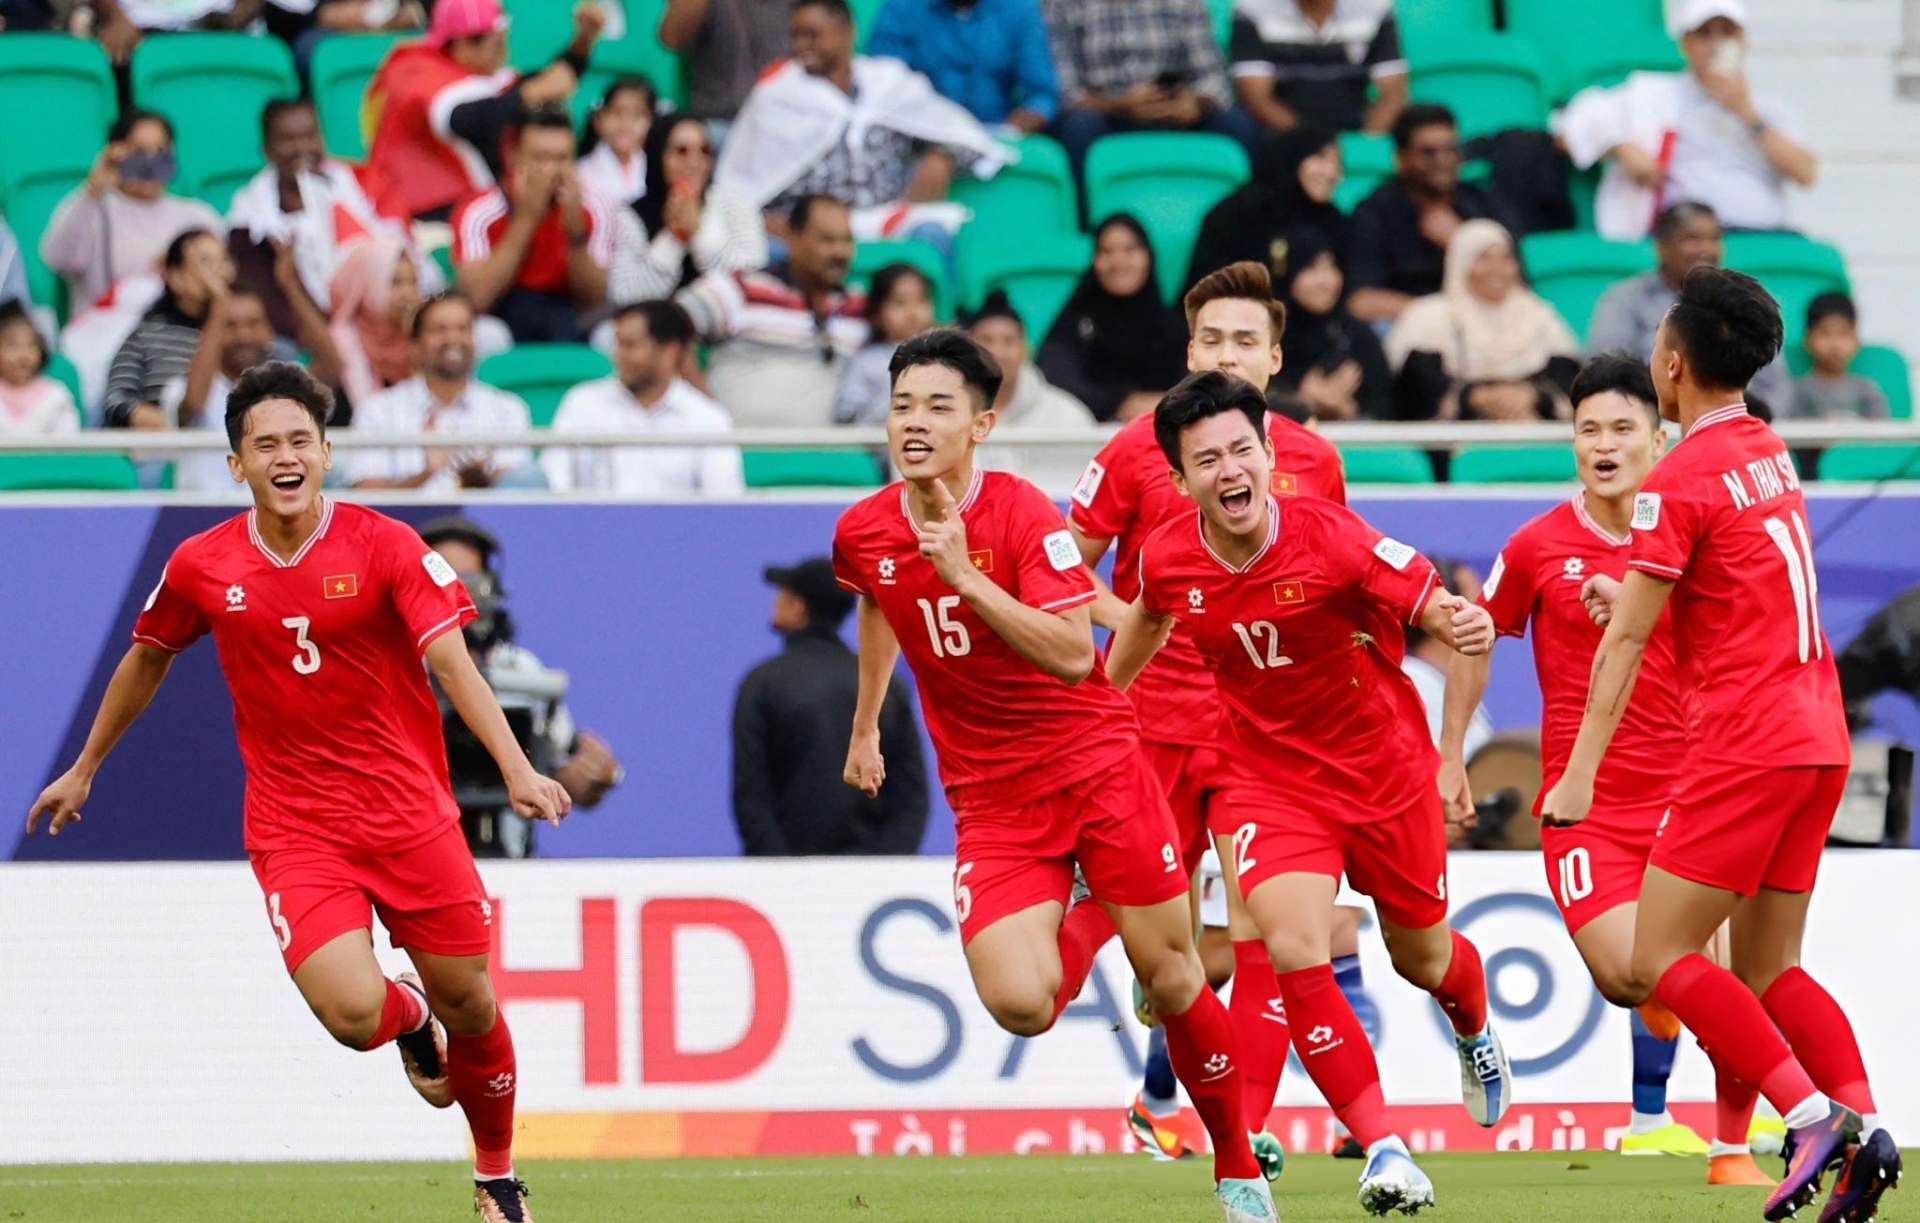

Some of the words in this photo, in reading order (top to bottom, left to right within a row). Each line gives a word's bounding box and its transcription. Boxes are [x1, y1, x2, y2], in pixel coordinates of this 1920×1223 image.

[1746, 456, 1784, 501] THAI
[281, 616, 321, 674] 3
[916, 595, 971, 658] 15
[1232, 620, 1294, 669] 12
[1558, 847, 1593, 907] 10
[269, 892, 291, 952] 3
[489, 896, 789, 1085] HD
